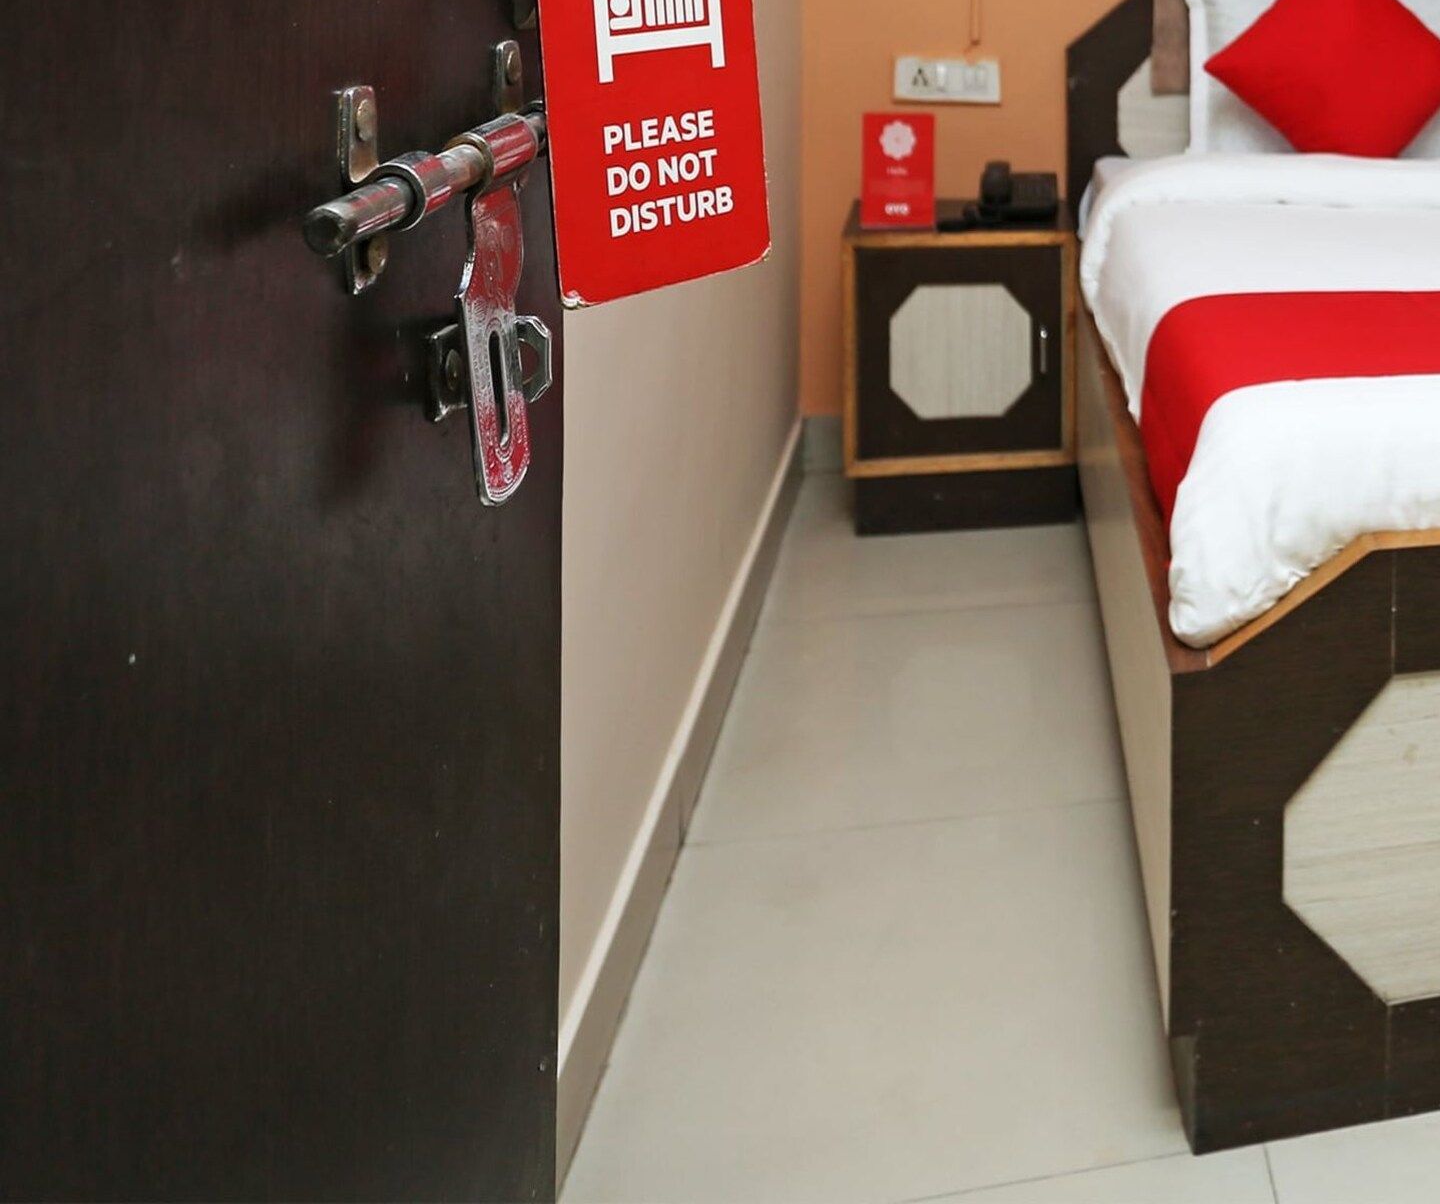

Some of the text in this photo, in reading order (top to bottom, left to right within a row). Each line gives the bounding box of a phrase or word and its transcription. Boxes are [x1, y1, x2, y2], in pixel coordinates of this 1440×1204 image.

[603, 109, 715, 155] PLEASE
[606, 148, 718, 196] DO NOT
[609, 186, 734, 238] DISTURB
